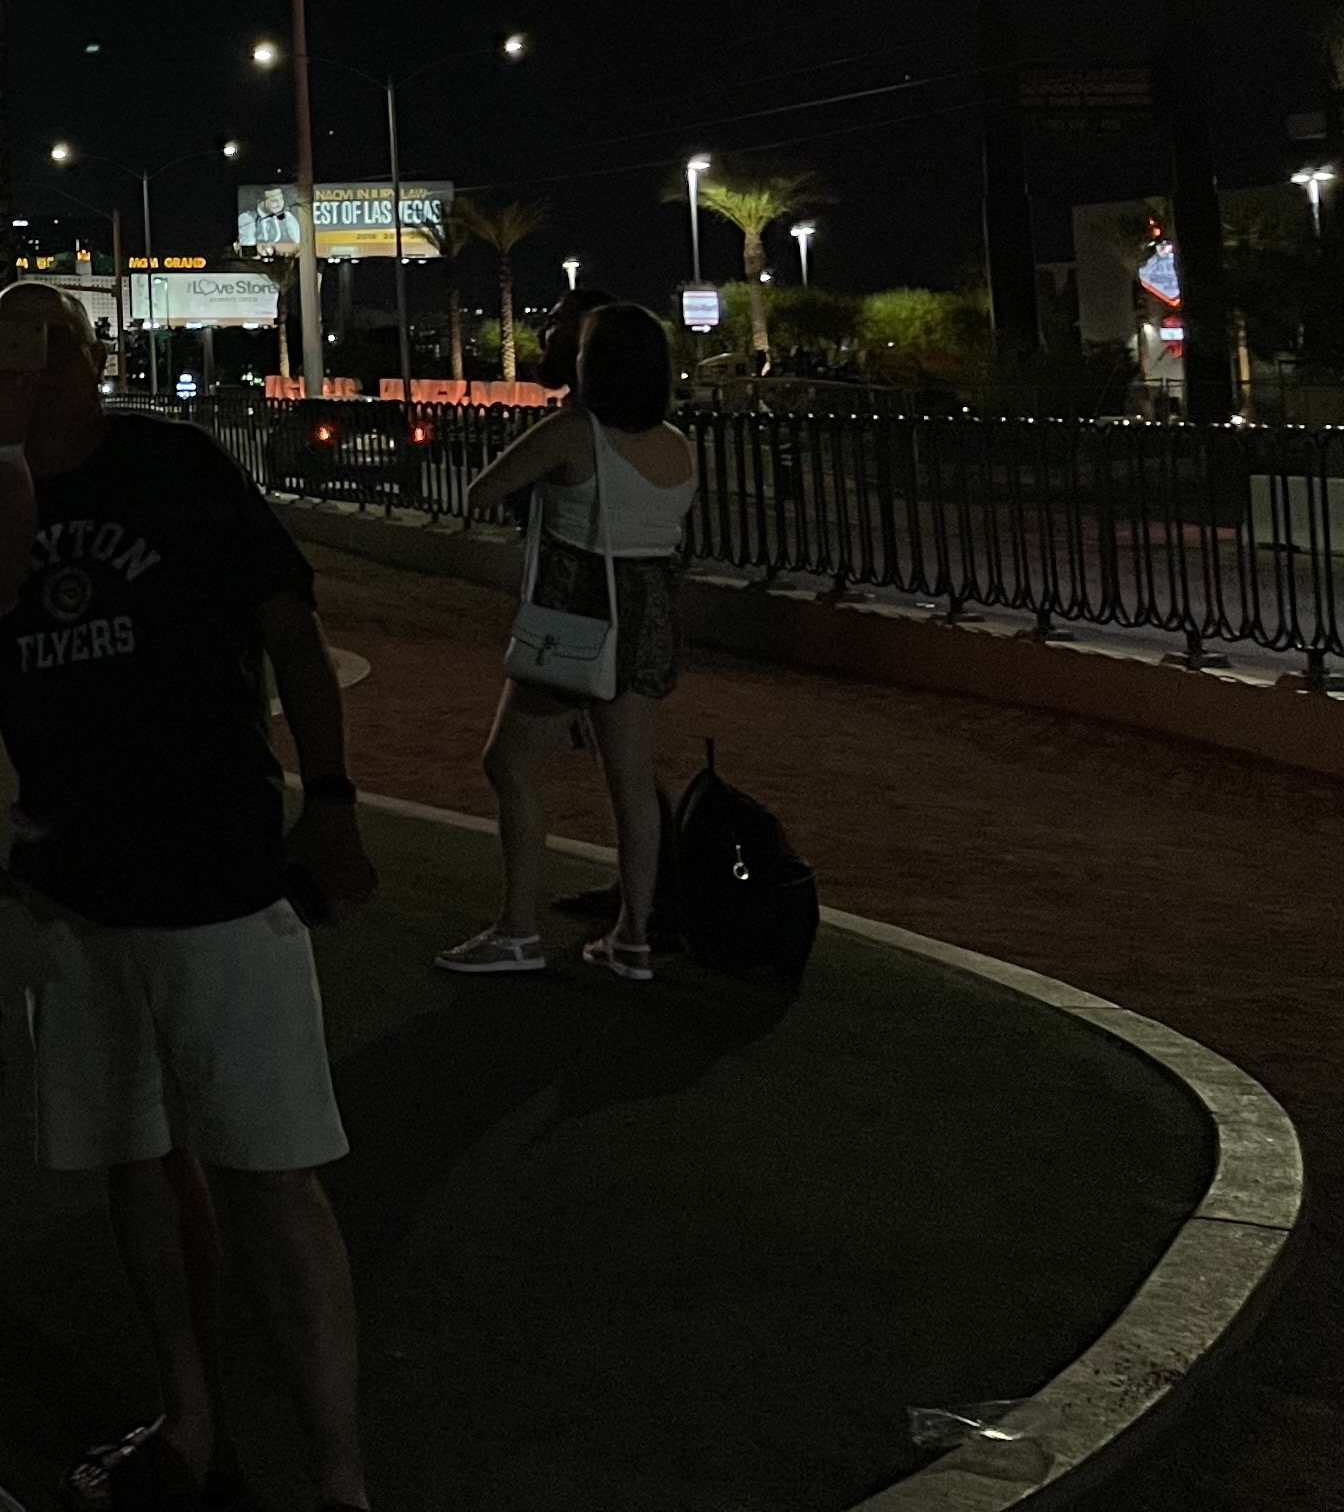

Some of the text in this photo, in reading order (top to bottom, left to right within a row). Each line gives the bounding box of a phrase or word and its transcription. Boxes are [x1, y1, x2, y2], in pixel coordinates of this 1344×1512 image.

[313, 201, 340, 225] EST
[342, 201, 362, 225] OF
[364, 201, 392, 225] LAS
[164, 257, 206, 268] GRAND
[16, 616, 136, 673] FLYERS
